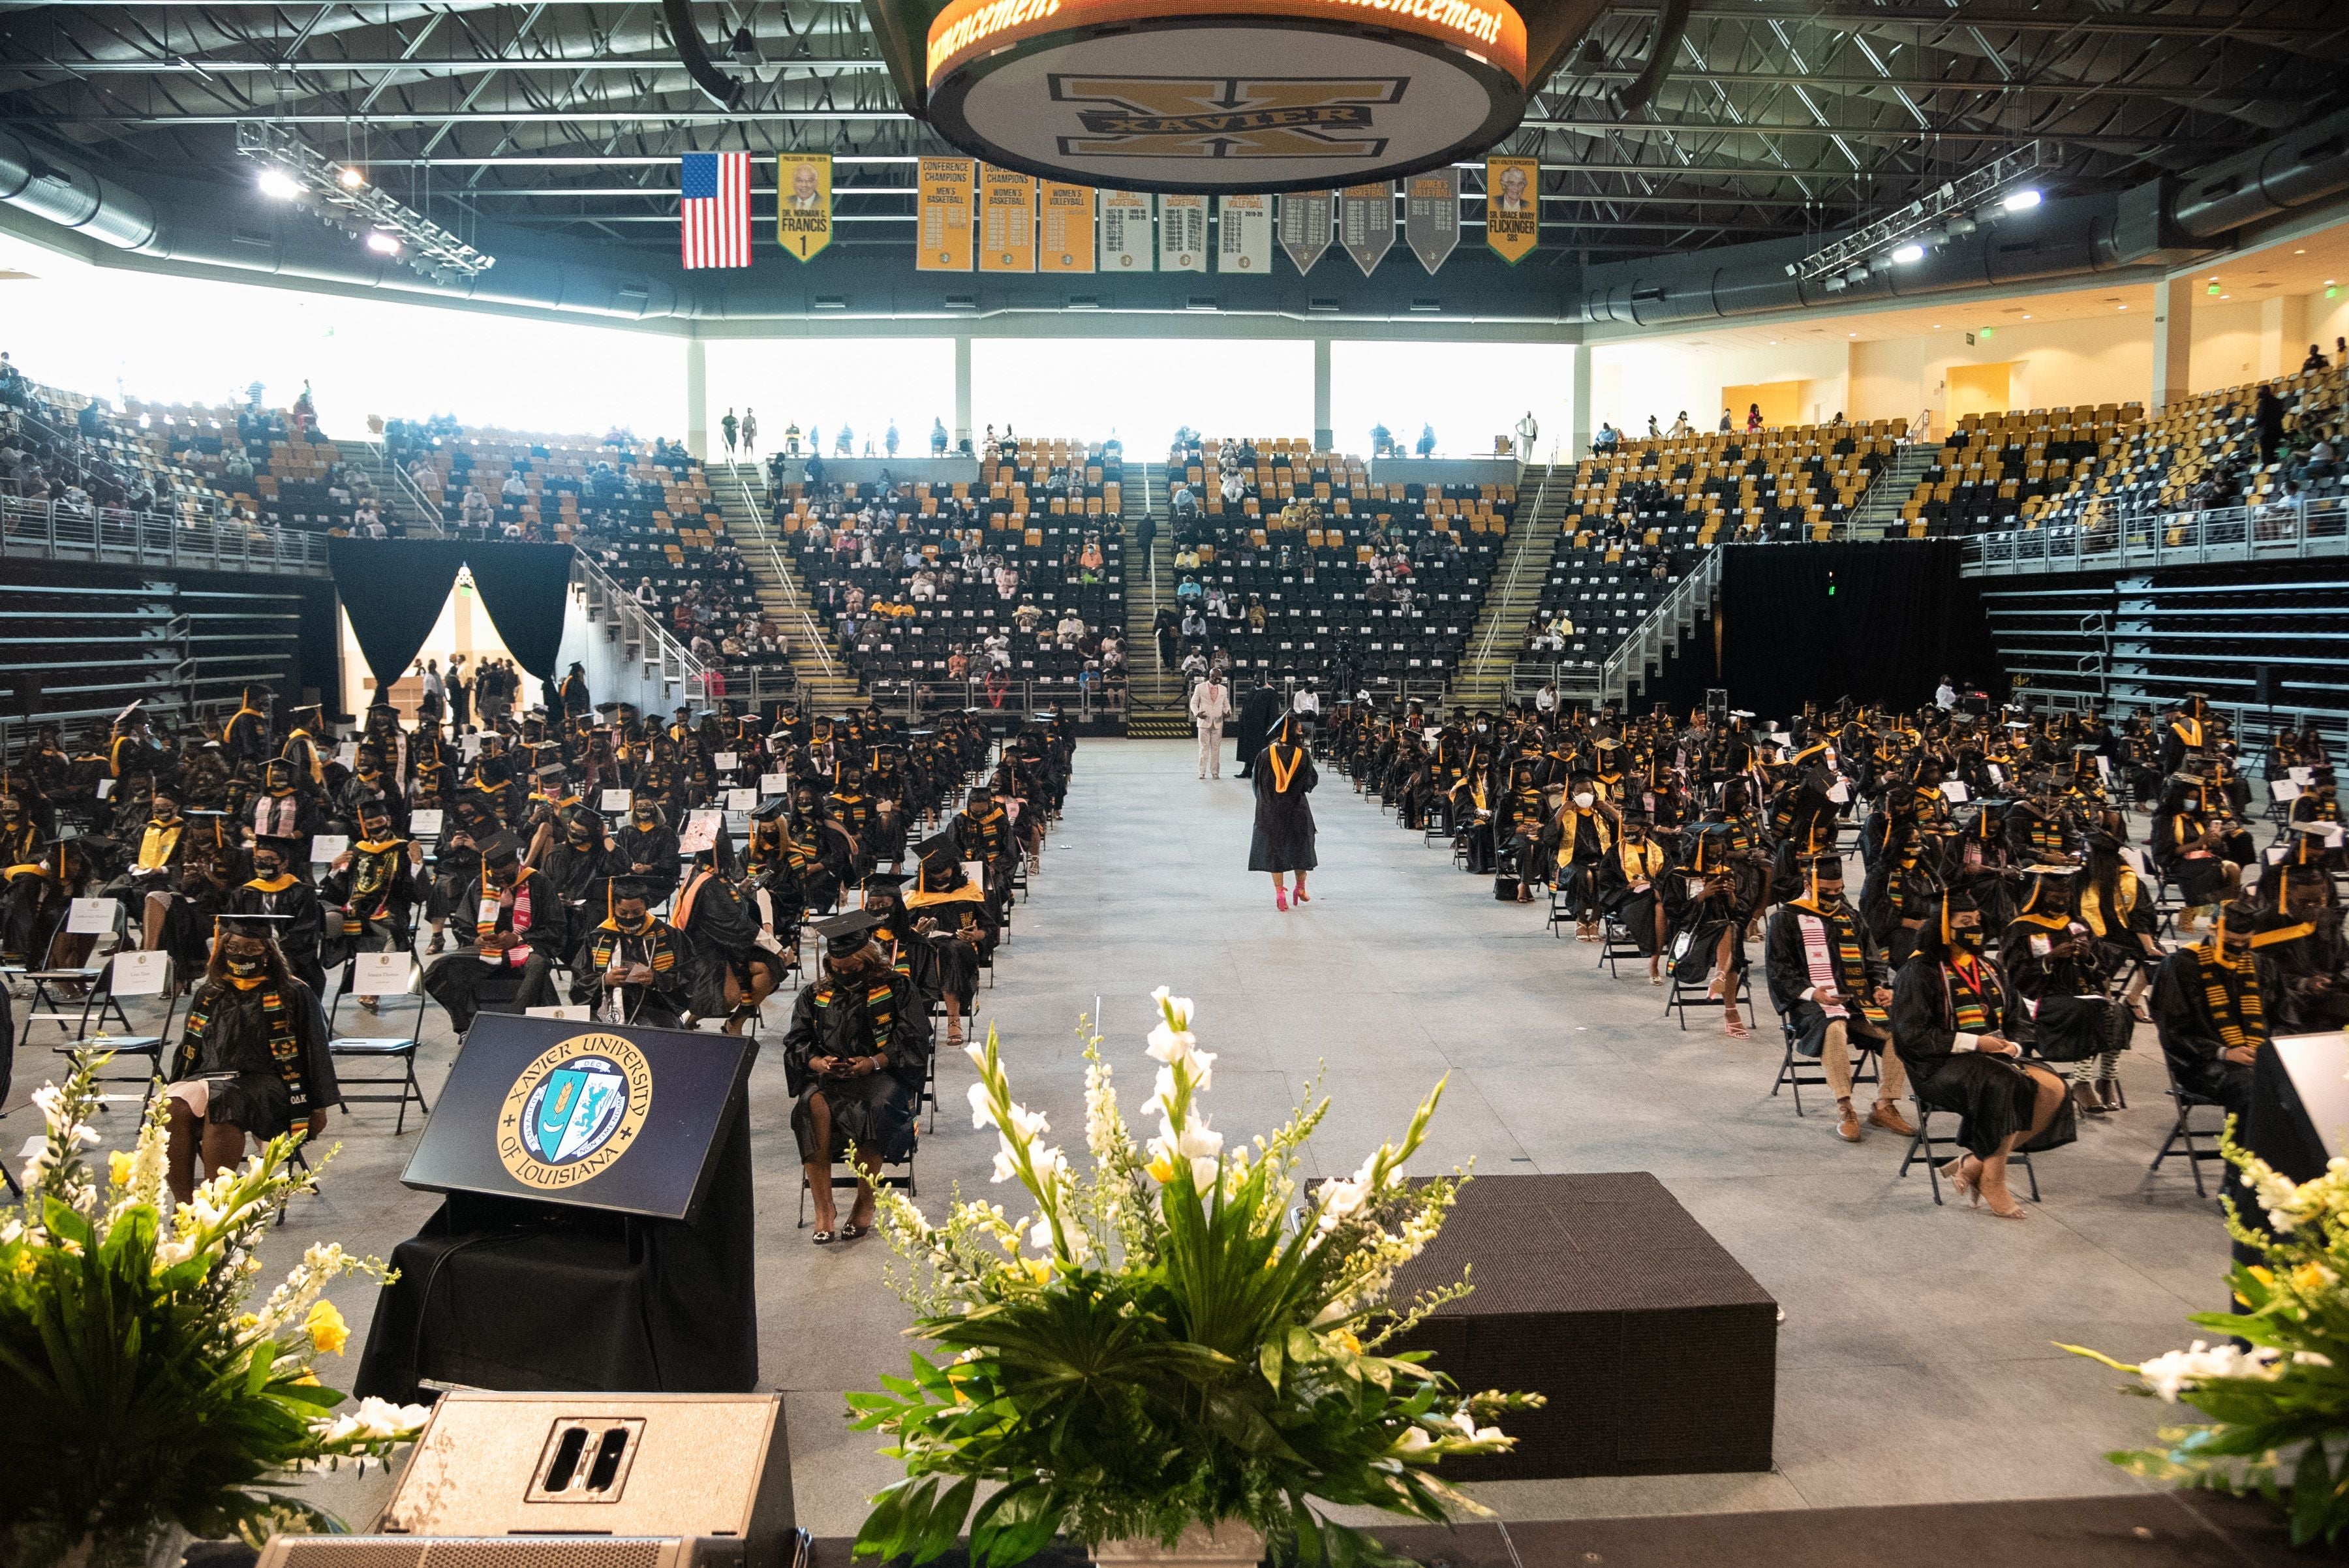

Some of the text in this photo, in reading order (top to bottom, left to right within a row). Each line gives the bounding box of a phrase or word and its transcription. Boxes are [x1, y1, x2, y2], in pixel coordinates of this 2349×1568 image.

[1103, 108, 1360, 132] XAVIER
[923, 161, 969, 172] CONFERENCE
[925, 172, 966, 183] CHAMPIONS
[987, 174, 1029, 184] CHAMPIONS
[1416, 179, 1449, 188] WOMEN'S
[936, 187, 956, 196] MEN'S
[1053, 189, 1082, 198] WOMEN'S
[1345, 189, 1389, 197] BASKETBALL
[1411, 189, 1452, 198] VOLLEYBALL
[927, 196, 964, 204] BASKETBALL
[989, 197, 1026, 206] BASKETBALL
[1049, 198, 1085, 206] VOLLEYBALL
[1228, 200, 1263, 208] VOLLEYBALL
[782, 218, 827, 232] FRANCIS
[1489, 220, 1535, 234] FLICKINGER
[799, 235, 806, 256] 1
[510, 1038, 649, 1116] XAVIER UNIVERSITY
[579, 1098, 622, 1154] NON TIMENDUM
[501, 1136, 619, 1185] OF LOUISIANA
